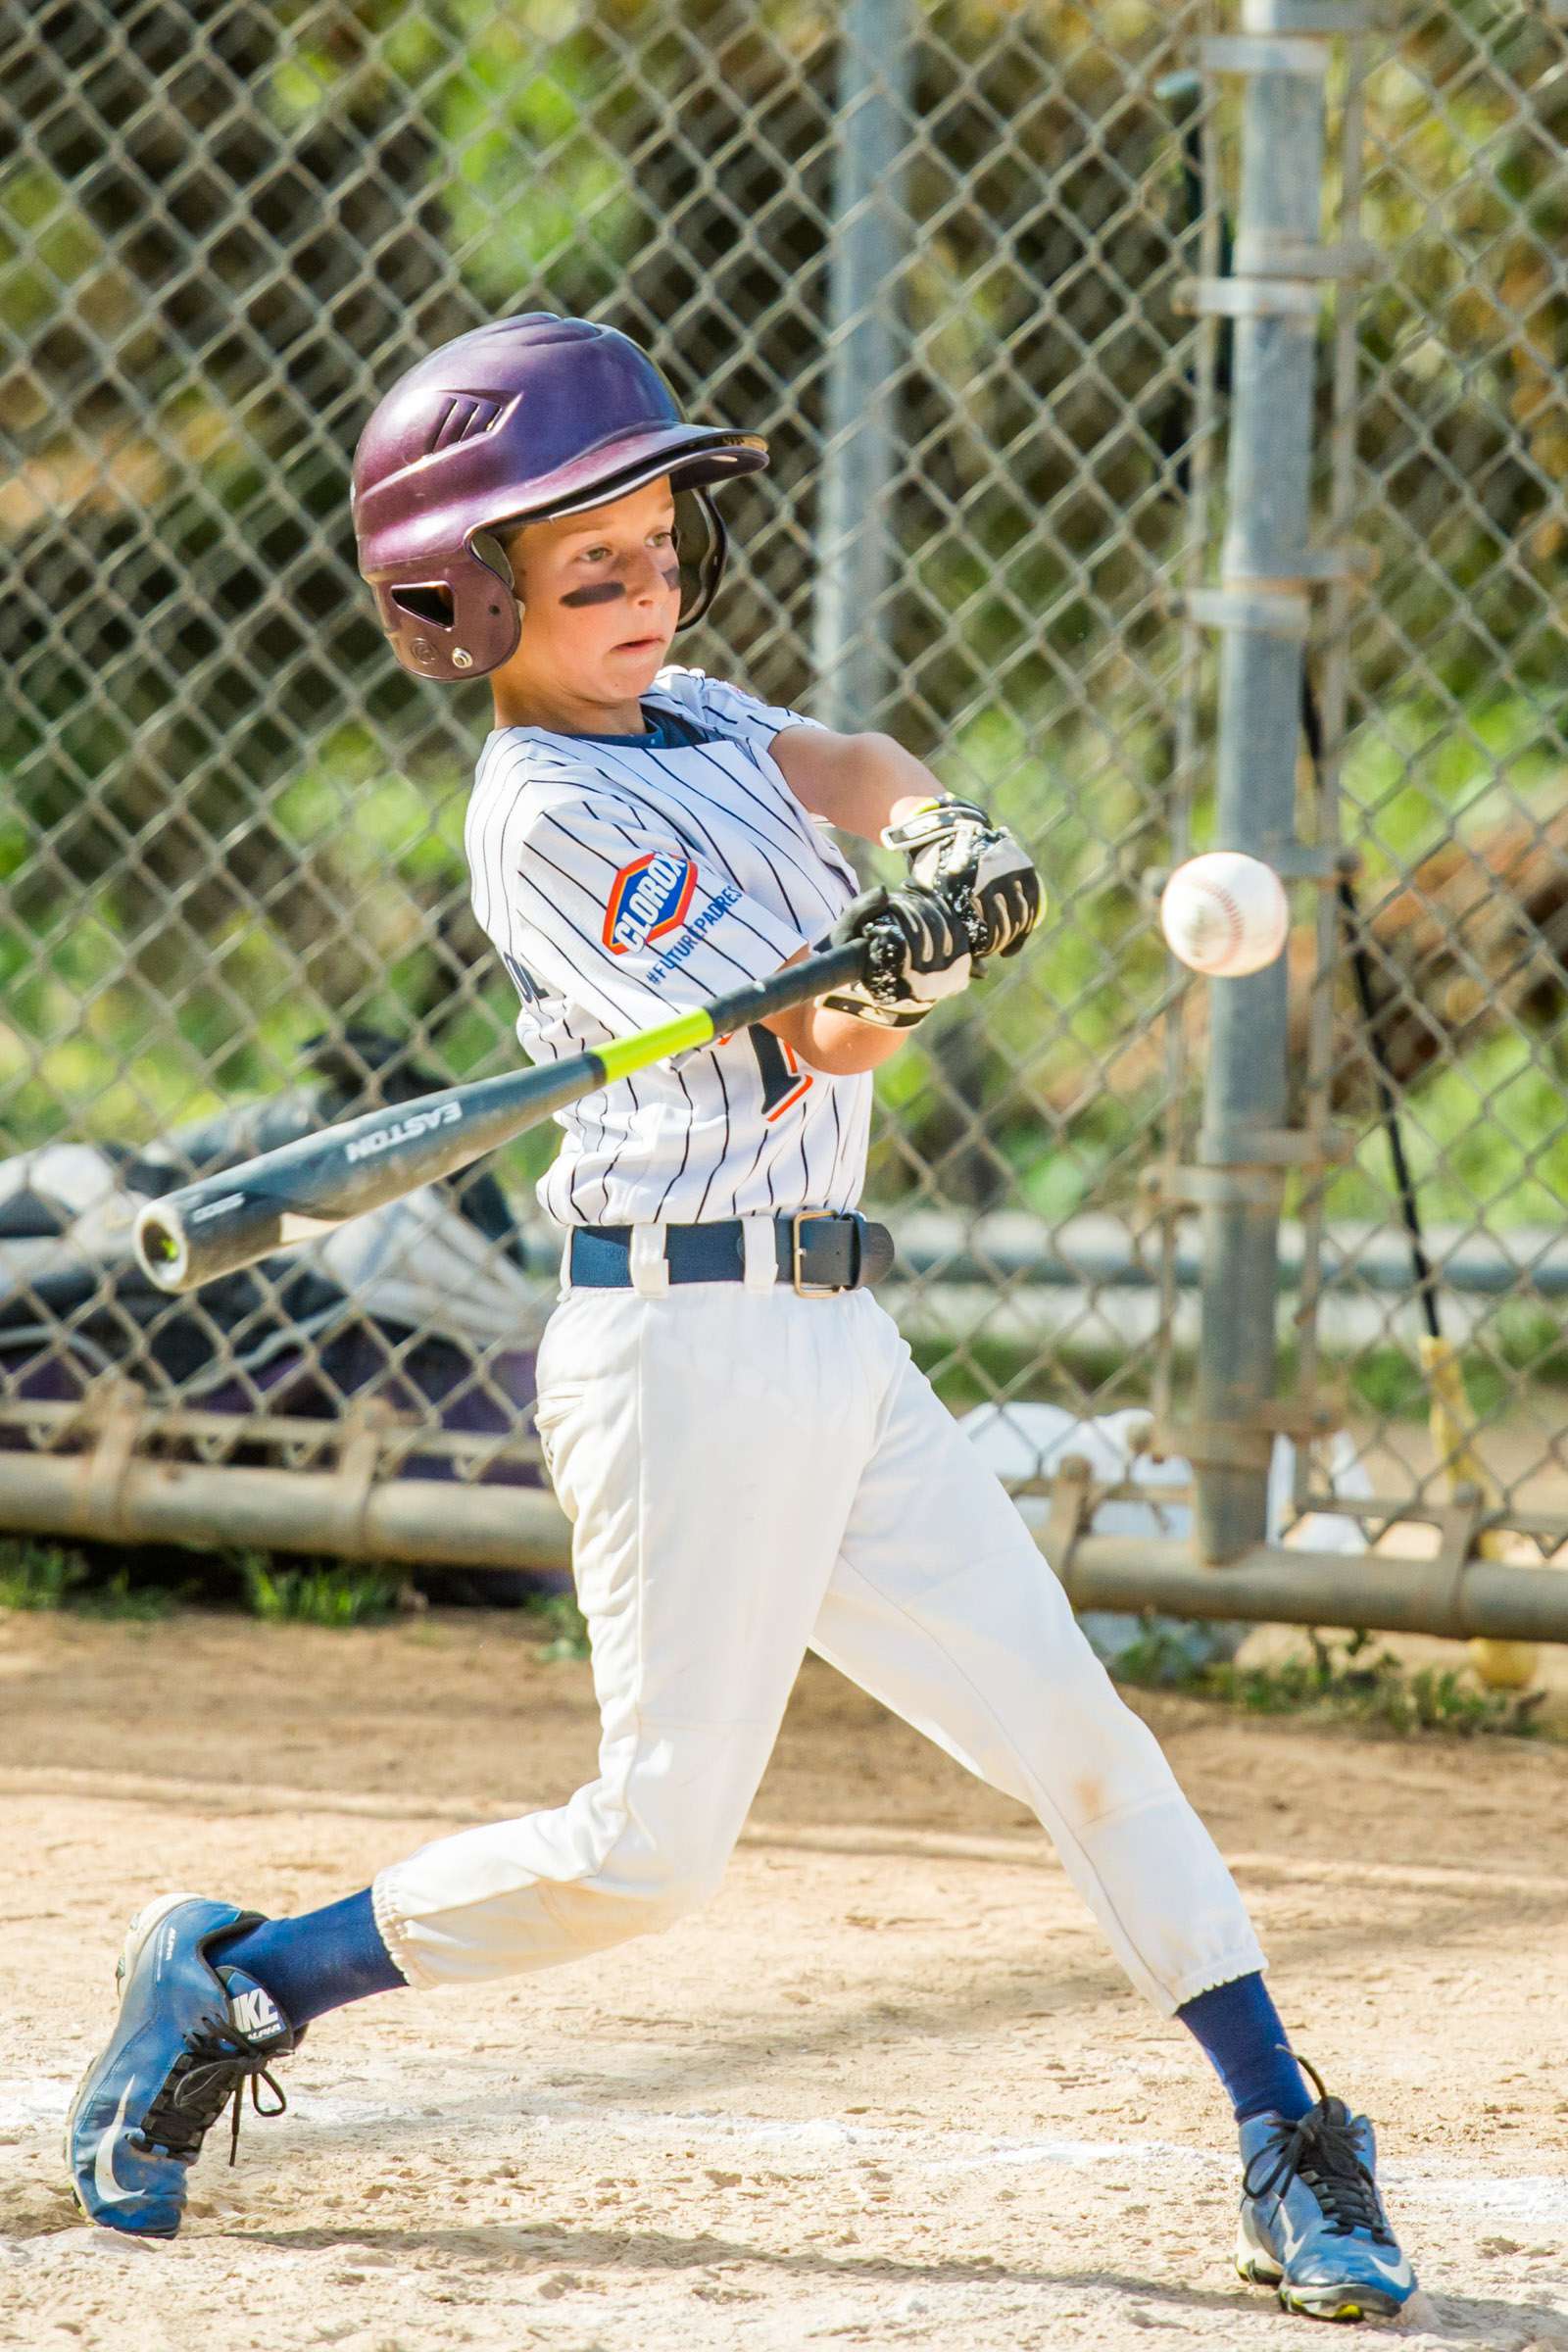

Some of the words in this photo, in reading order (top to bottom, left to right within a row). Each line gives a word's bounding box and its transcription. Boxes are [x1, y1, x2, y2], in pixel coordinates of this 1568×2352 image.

[614, 852, 686, 954] CLOROX
[345, 1100, 463, 1163] EASTON
[232, 1987, 278, 2033] IKE
